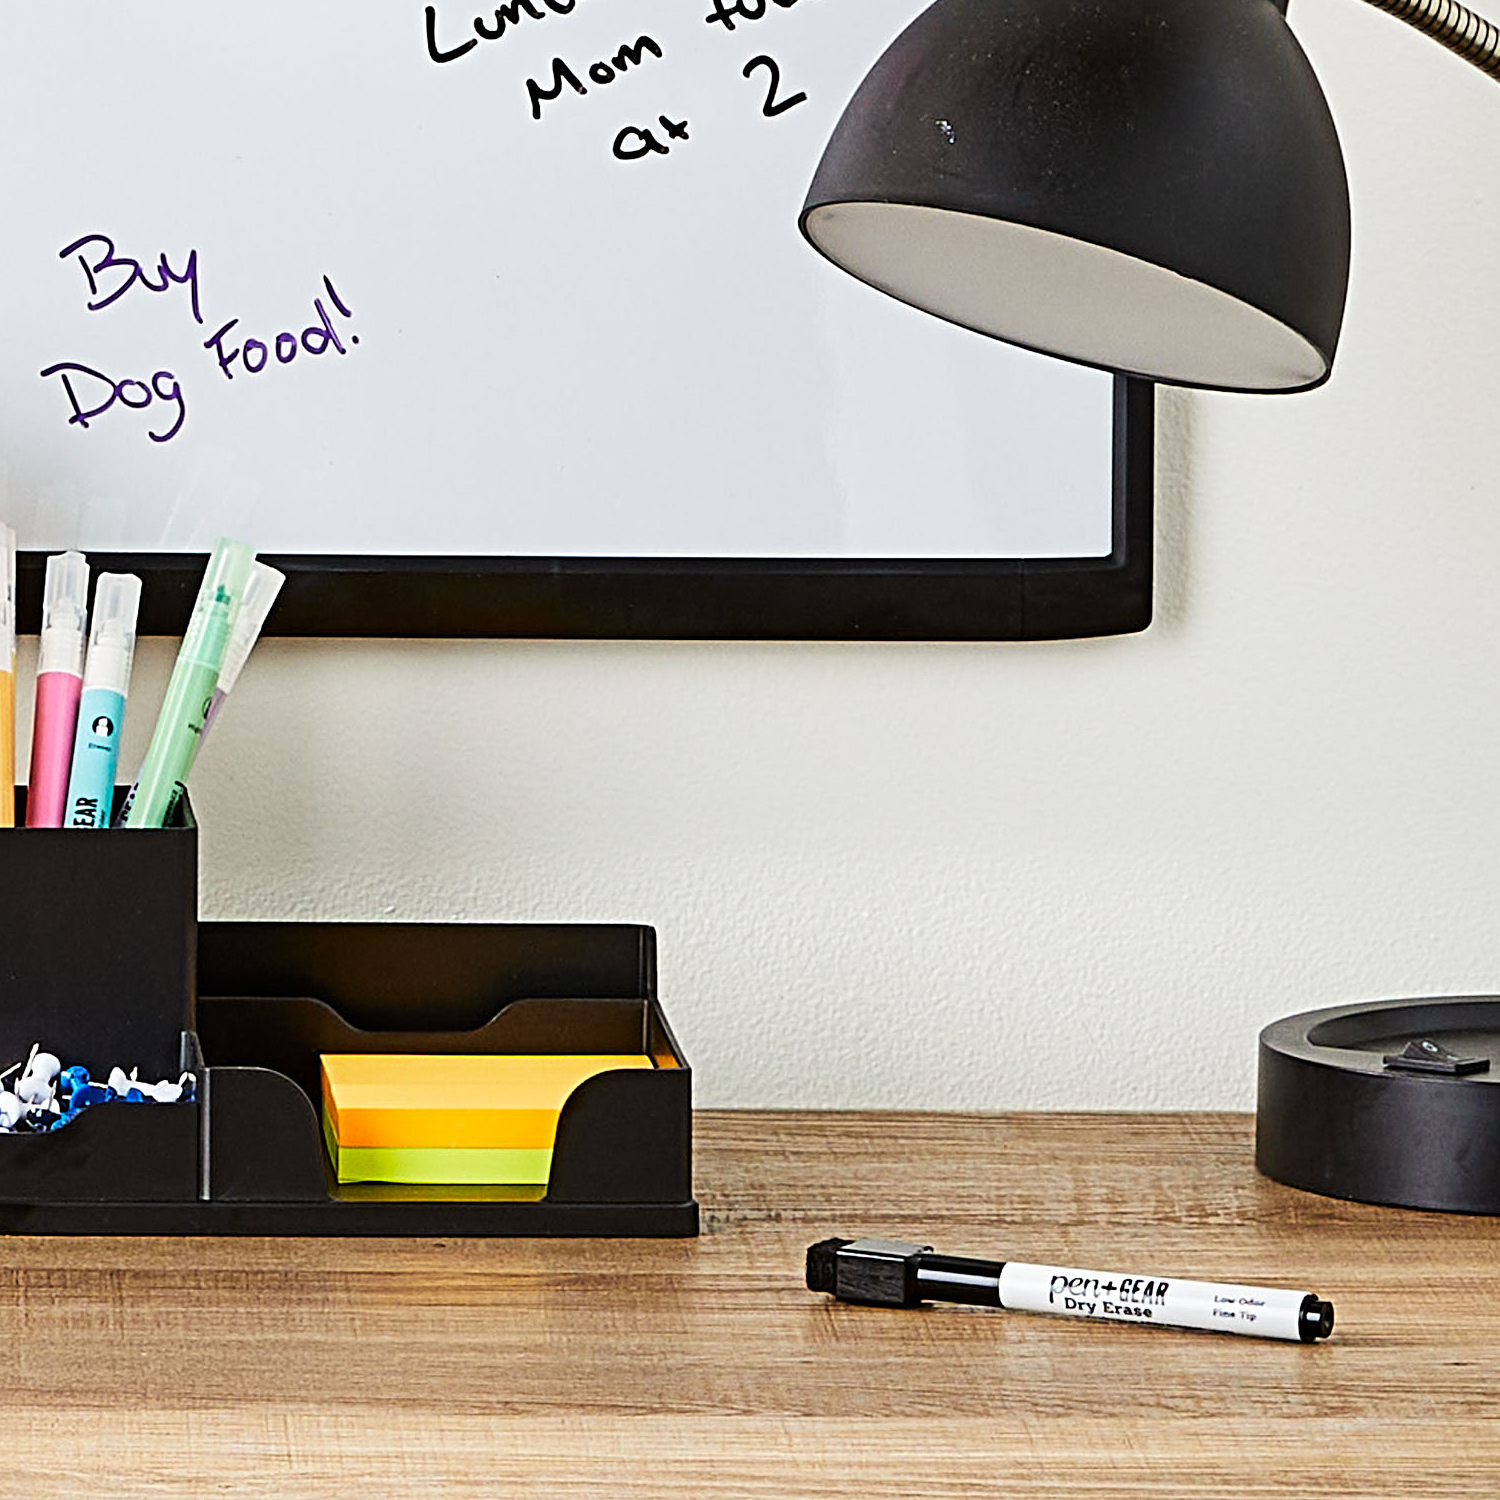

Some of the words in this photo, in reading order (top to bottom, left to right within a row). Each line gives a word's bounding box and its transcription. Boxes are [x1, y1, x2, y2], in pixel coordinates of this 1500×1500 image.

[525, 35, 663, 120] Mom
[612, 114, 689, 160] at
[742, 54, 808, 118] 2
[59, 234, 203, 324] Buy
[40, 362, 185, 442] Dog
[203, 275, 360, 380] Food!
[1064, 1297, 1097, 1314] Dry
[1103, 1301, 1153, 1318] Erase
